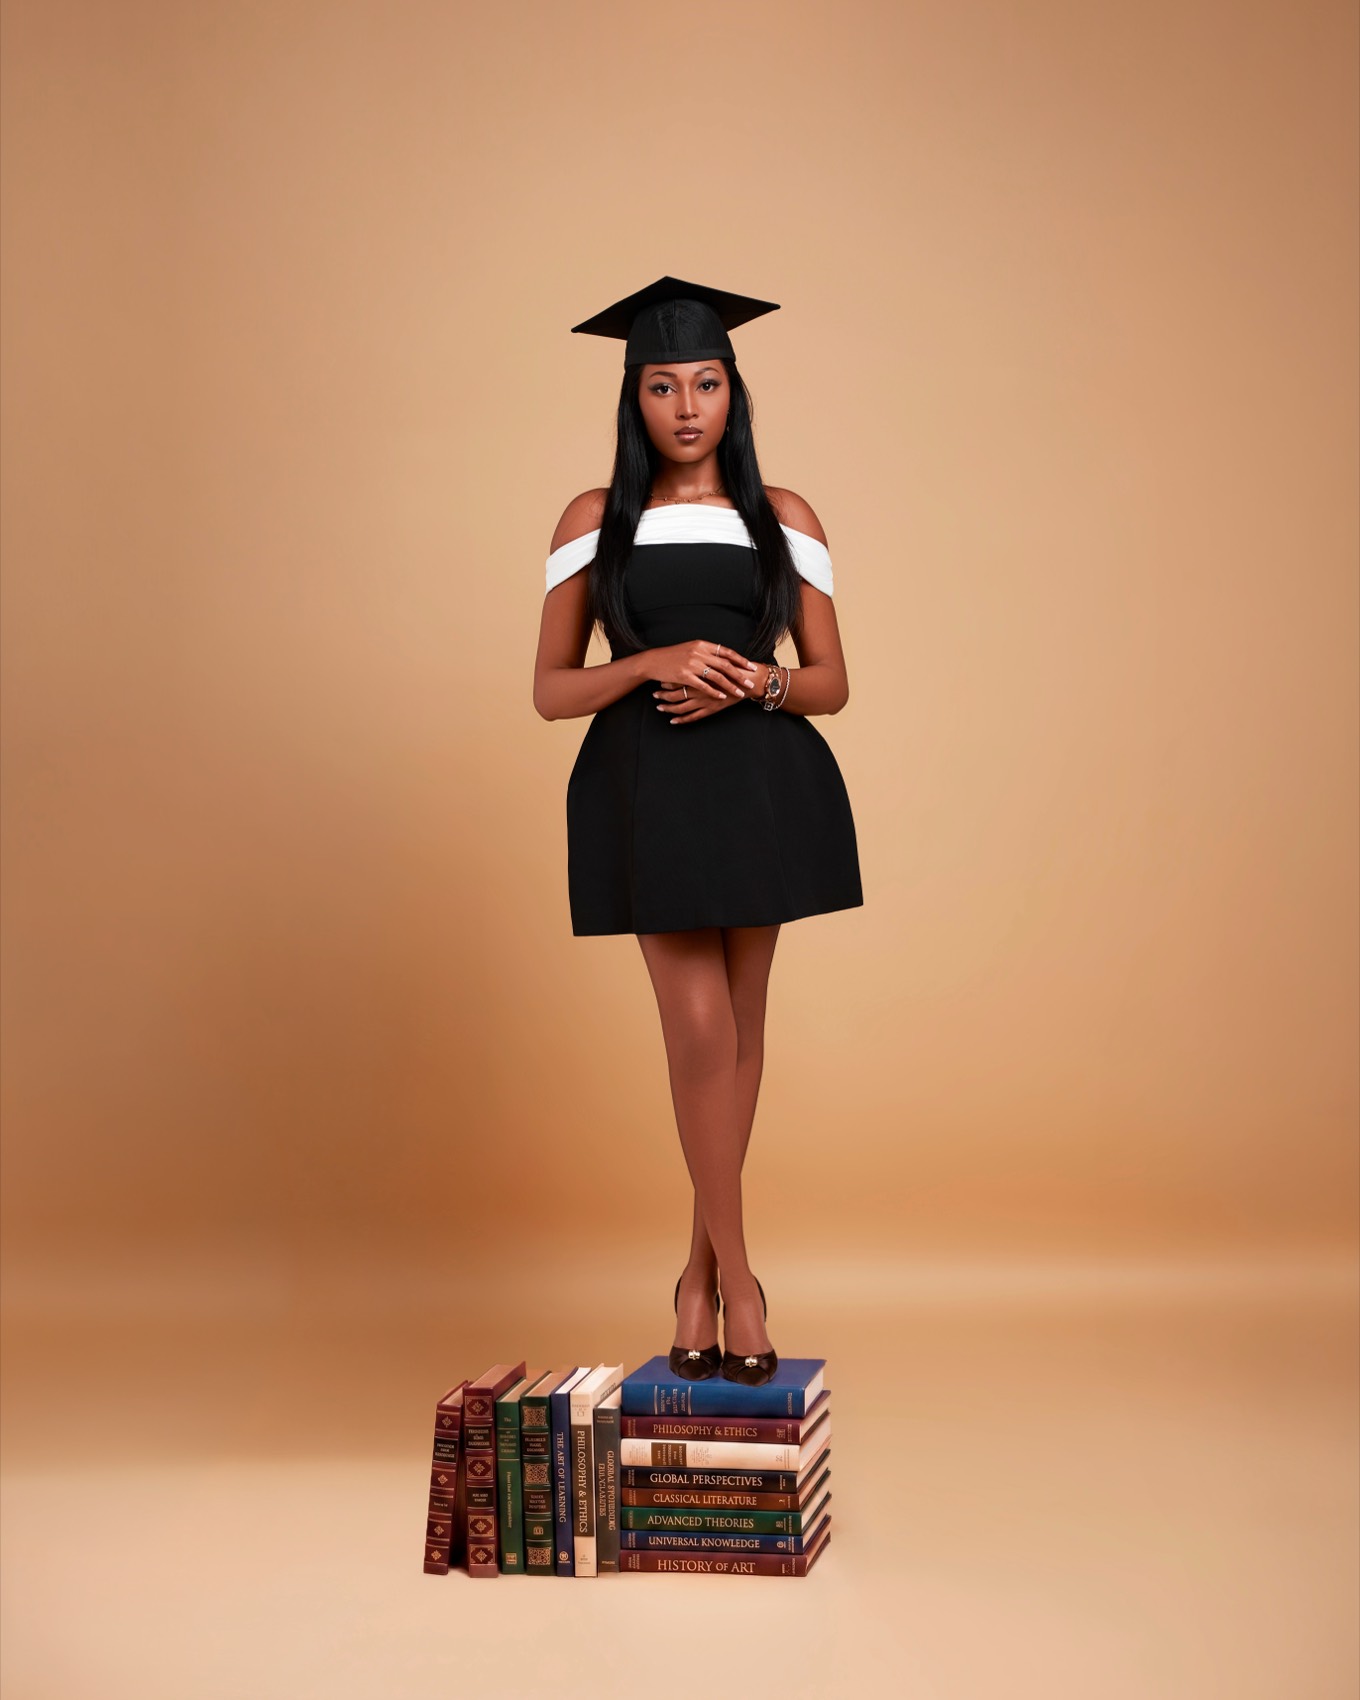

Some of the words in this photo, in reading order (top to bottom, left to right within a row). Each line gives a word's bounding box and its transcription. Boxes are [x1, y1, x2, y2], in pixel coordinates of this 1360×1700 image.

[653, 1424, 713, 1436] PHILOSOPHY
[715, 1426, 723, 1435] &
[724, 1427, 758, 1437] ETHICS
[556, 1432, 564, 1449] THE
[577, 1430, 587, 1488] PHILOSOPHY
[558, 1468, 565, 1479] OF
[650, 1473, 690, 1484] GLOBAL
[693, 1475, 763, 1487] PERSPECTIVES
[578, 1490, 587, 1498] &
[653, 1494, 701, 1504] CLASSICAL
[703, 1495, 757, 1506] LITERATURE
[579, 1500, 588, 1533] ETHICS
[647, 1515, 702, 1527] ADVANCED
[704, 1517, 754, 1529] THEORIES
[649, 1536, 699, 1546] UNIVERSAL
[701, 1537, 760, 1548] KNOWLEDGE
[657, 1560, 713, 1572] HISTORY
[731, 1562, 756, 1573] ART
